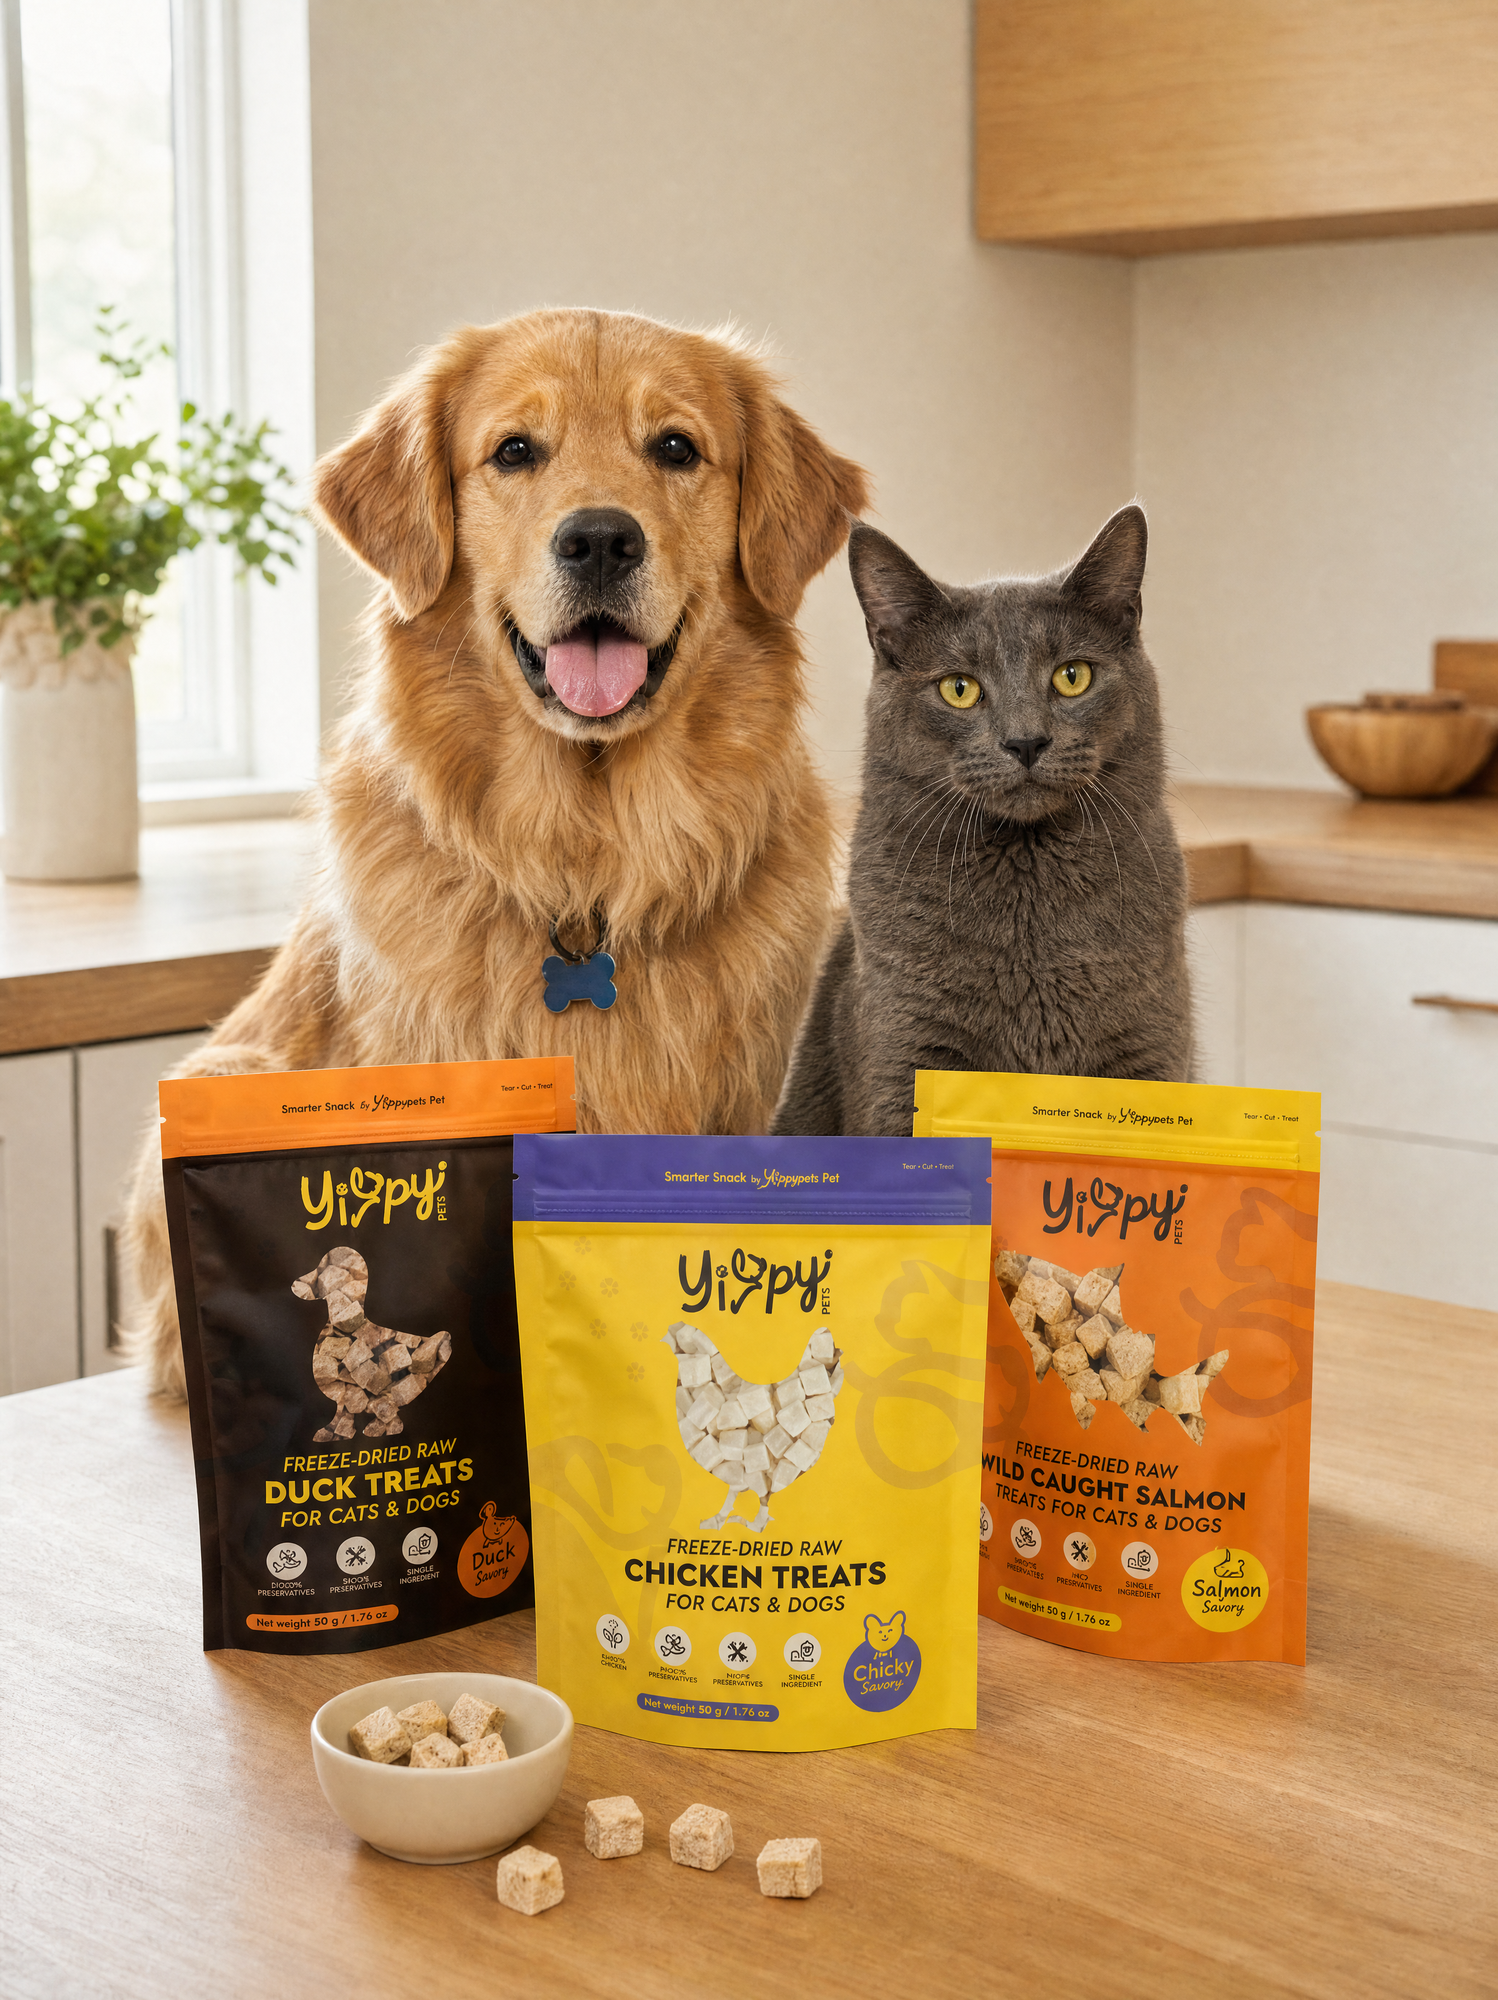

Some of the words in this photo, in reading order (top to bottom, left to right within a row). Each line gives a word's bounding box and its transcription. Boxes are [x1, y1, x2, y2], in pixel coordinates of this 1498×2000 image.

[282, 1103, 322, 1114] Smarter
[325, 1101, 355, 1111] Snack
[360, 1101, 370, 1111] by
[430, 1095, 445, 1105] Pet
[1032, 1106, 1071, 1117] Smarter
[1073, 1108, 1103, 1119] Snack
[1107, 1113, 1117, 1122] by
[1178, 1116, 1193, 1126] Pet
[664, 1171, 710, 1183] Smarter
[713, 1172, 747, 1183] Snack
[751, 1174, 761, 1185] by
[822, 1173, 840, 1183] Pet
[437, 1195, 448, 1221] PETS
[1174, 1219, 1184, 1245] PETS
[821, 1287, 831, 1315] PETS
[283, 1445, 411, 1472] FREEZE-DRIED
[417, 1438, 457, 1458] RAW
[1015, 1441, 1130, 1475] FREEZE-DRIED
[1135, 1461, 1179, 1480] RAW
[265, 1475, 357, 1504] DUCK
[365, 1457, 474, 1496] TREATS
[982, 1451, 1025, 1482] WILD
[1031, 1467, 1129, 1502] CAUGHT
[1136, 1485, 1246, 1511] SALMON
[280, 1510, 322, 1527] FOR
[329, 1503, 379, 1525] CATS
[386, 1501, 399, 1517] &
[406, 1490, 460, 1514] DOGS
[995, 1483, 1046, 1511] TREATS
[1051, 1499, 1086, 1520] FOR
[1092, 1507, 1139, 1528] CATS
[1145, 1513, 1158, 1530] &
[1165, 1515, 1222, 1533] DOGS
[472, 1542, 516, 1571] Duck
[667, 1538, 793, 1557] FREEZE-DRIED
[799, 1539, 843, 1557] RAW
[399, 1571, 440, 1585] INGREDIENT
[406, 1565, 434, 1576] SINGLE
[475, 1567, 509, 1586] Savory
[624, 1558, 762, 1589] CHICKEN
[772, 1561, 887, 1589] TREATS
[257, 1588, 316, 1597] PRESERVATIVES
[1117, 1588, 1161, 1599] INGREDIENT
[1125, 1580, 1153, 1590] SINGLE
[1192, 1579, 1261, 1598] Salmon
[666, 1593, 704, 1611] FOR
[711, 1595, 760, 1613] CATS
[767, 1597, 781, 1613] &
[788, 1595, 845, 1613] DOGS
[1004, 1592, 1018, 1603] Net
[1018, 1598, 1045, 1613] weight
[1047, 1605, 1058, 1616] 50
[1060, 1610, 1067, 1620] g
[1068, 1610, 1074, 1620] /
[1076, 1612, 1096, 1624] 1.76
[1098, 1618, 1110, 1627] oz
[1201, 1599, 1245, 1617] Savory
[256, 1618, 274, 1628] Net
[276, 1618, 311, 1630] weight
[314, 1617, 328, 1626] 50
[331, 1618, 339, 1627] g
[341, 1614, 347, 1624] /
[350, 1612, 373, 1623] 1.76
[375, 1611, 388, 1619] oz
[600, 1660, 627, 1671] CHICKEN
[853, 1658, 914, 1681] Chicky
[648, 1671, 698, 1683] PRESERVATIVES
[712, 1679, 763, 1688] PRESERVATIVES
[860, 1679, 904, 1695] Savory
[644, 1697, 661, 1709] Net
[663, 1701, 696, 1715] weight
[698, 1705, 712, 1715] 50
[714, 1707, 722, 1717] g
[724, 1706, 730, 1716] /
[732, 1707, 755, 1717] 1.76
[758, 1709, 770, 1718] oz
